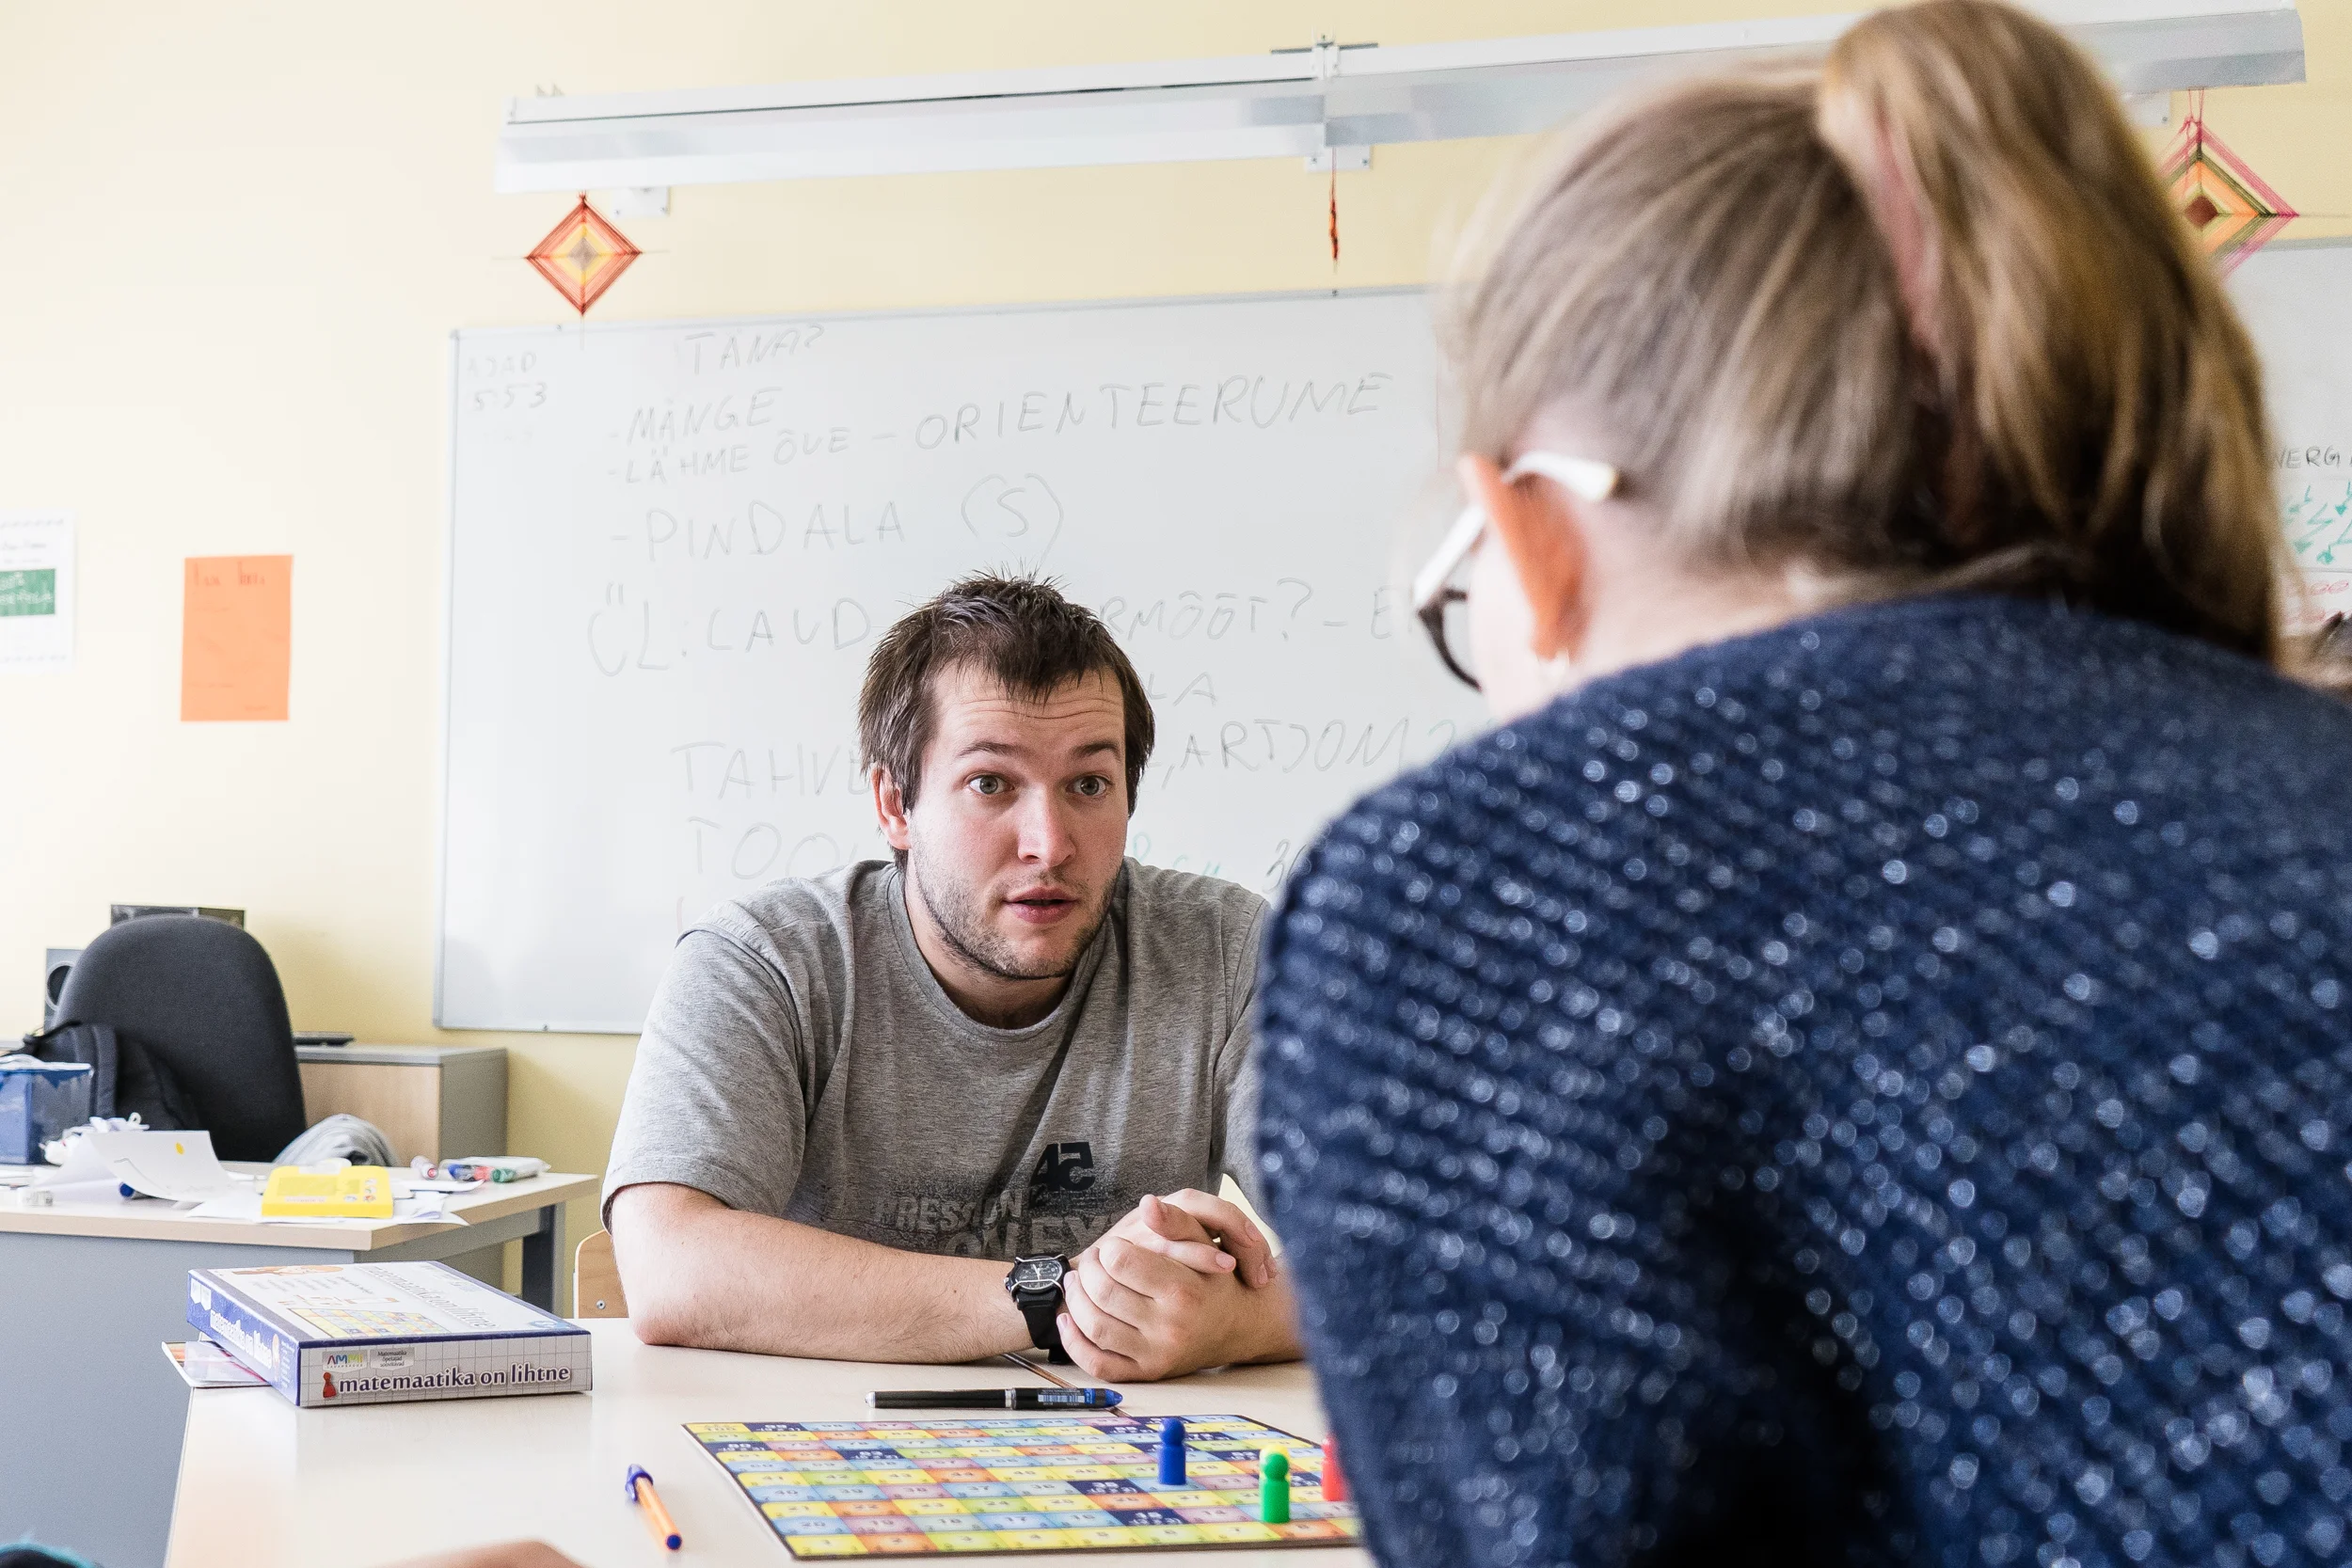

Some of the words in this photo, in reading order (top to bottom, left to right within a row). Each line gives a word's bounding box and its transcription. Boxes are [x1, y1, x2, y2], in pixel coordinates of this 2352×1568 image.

[914, 372, 1393, 450] ORIENTEERUME
[340, 1367, 475, 1393] matemaatika
[480, 1372, 505, 1386] on
[511, 1363, 570, 1384] lihtne
